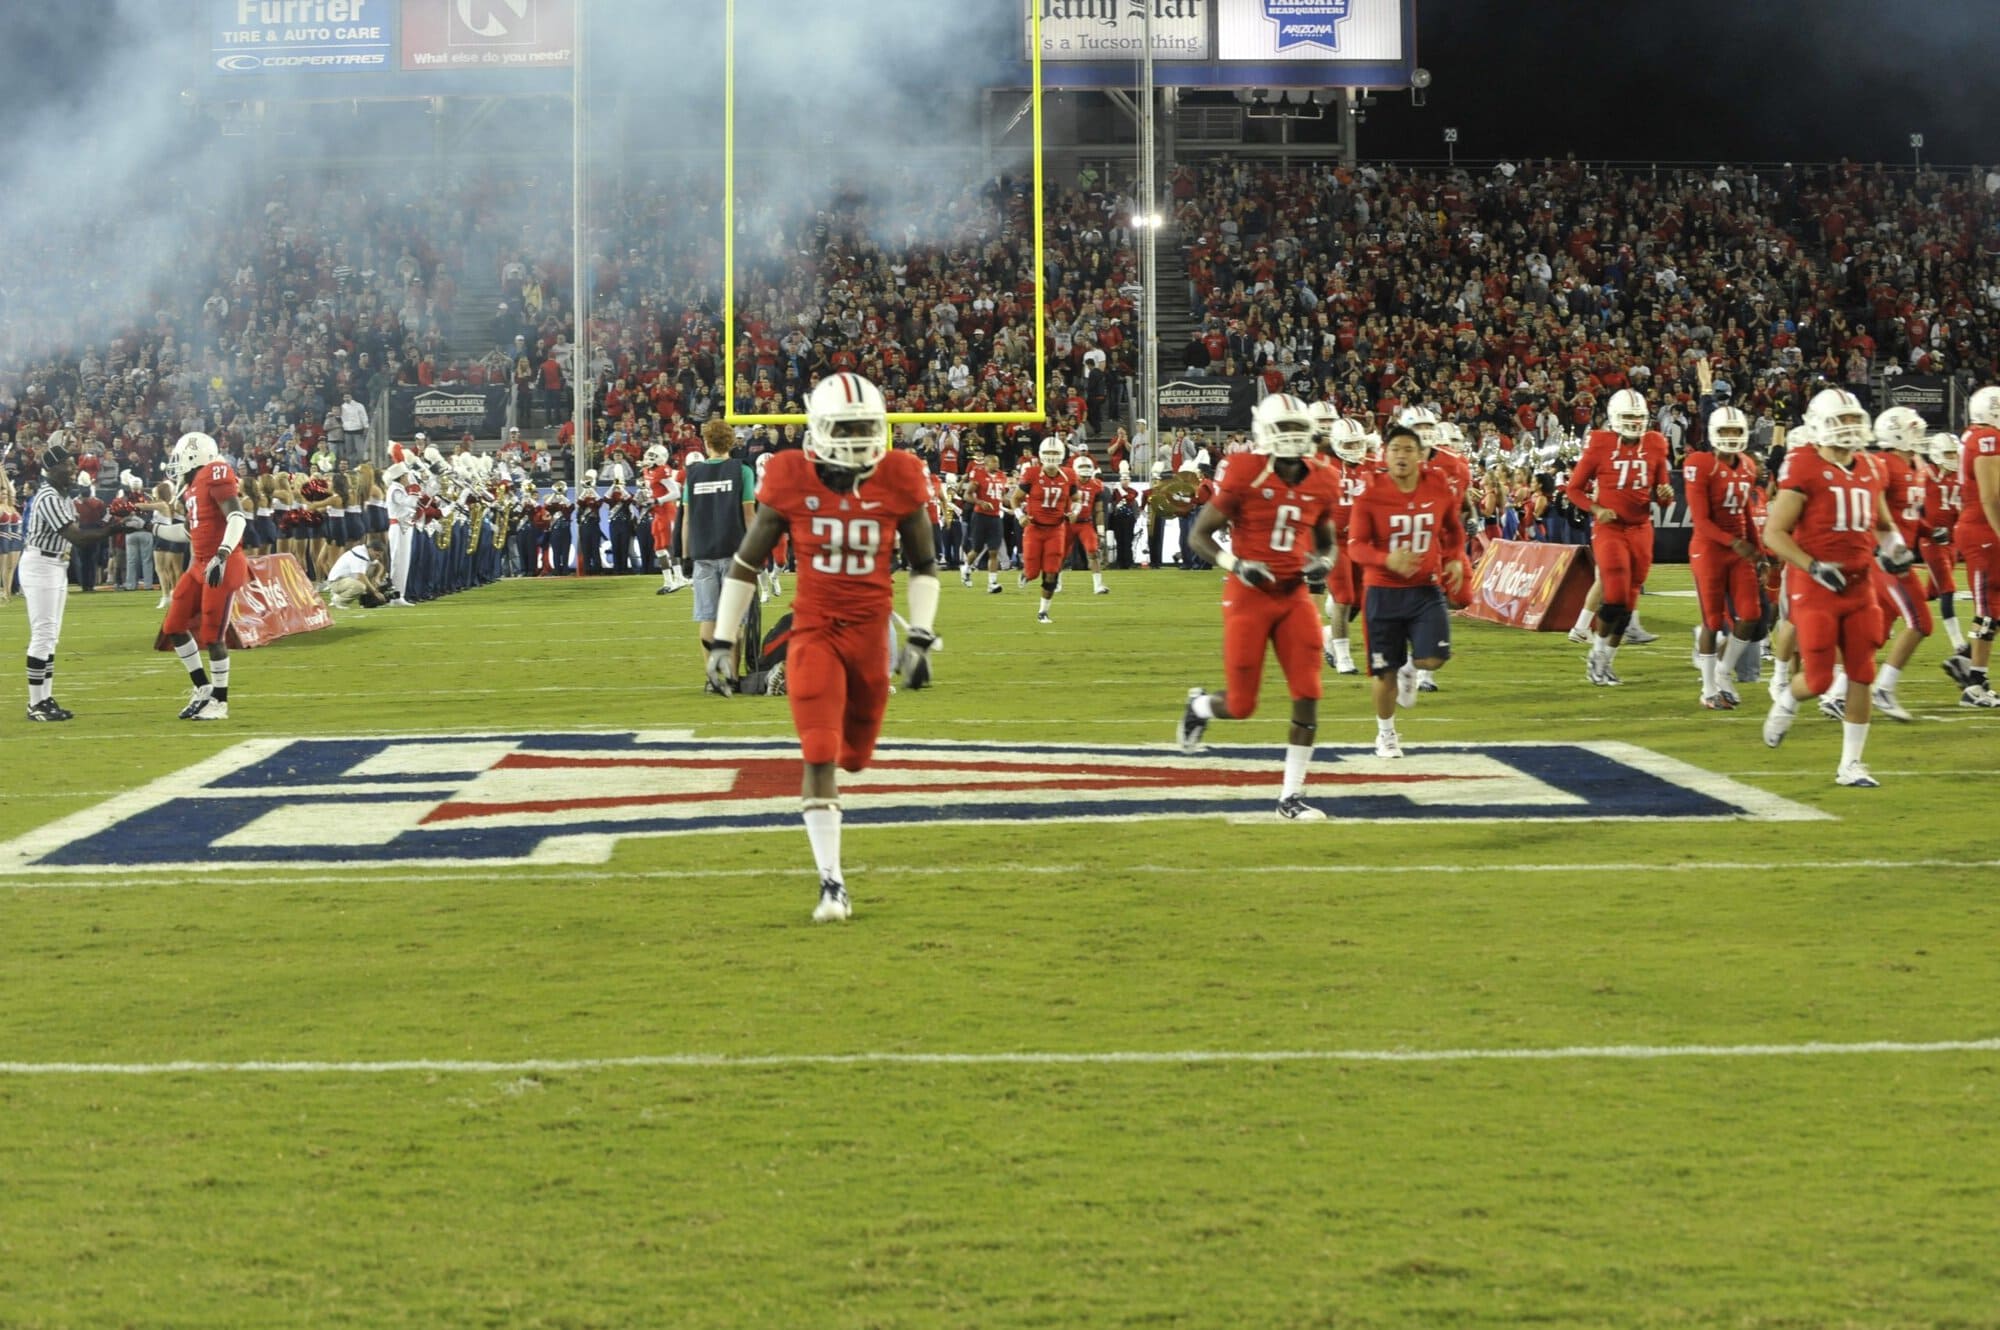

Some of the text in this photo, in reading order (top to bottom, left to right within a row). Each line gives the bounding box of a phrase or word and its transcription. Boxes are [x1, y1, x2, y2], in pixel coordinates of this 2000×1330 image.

[222, 27, 382, 43] TIRE & AUTO CARE
[1281, 24, 1332, 34] ARIZONA
[1060, 38, 1072, 49] a
[1077, 34, 1142, 49] Tucson
[413, 50, 571, 64] What else do you need?
[1159, 389, 1230, 397] AMERICAN FAMILY
[415, 399, 455, 407] AMERICAN
[213, 465, 228, 480] 27
[1613, 460, 1648, 490] 73
[693, 480, 733, 495] ESPN
[1041, 487, 1062, 508] 17
[1722, 482, 1750, 515] 47
[1828, 486, 1872, 532] 10
[1269, 505, 1302, 552] 6
[1389, 513, 1434, 554] 26
[812, 517, 881, 575] 39
